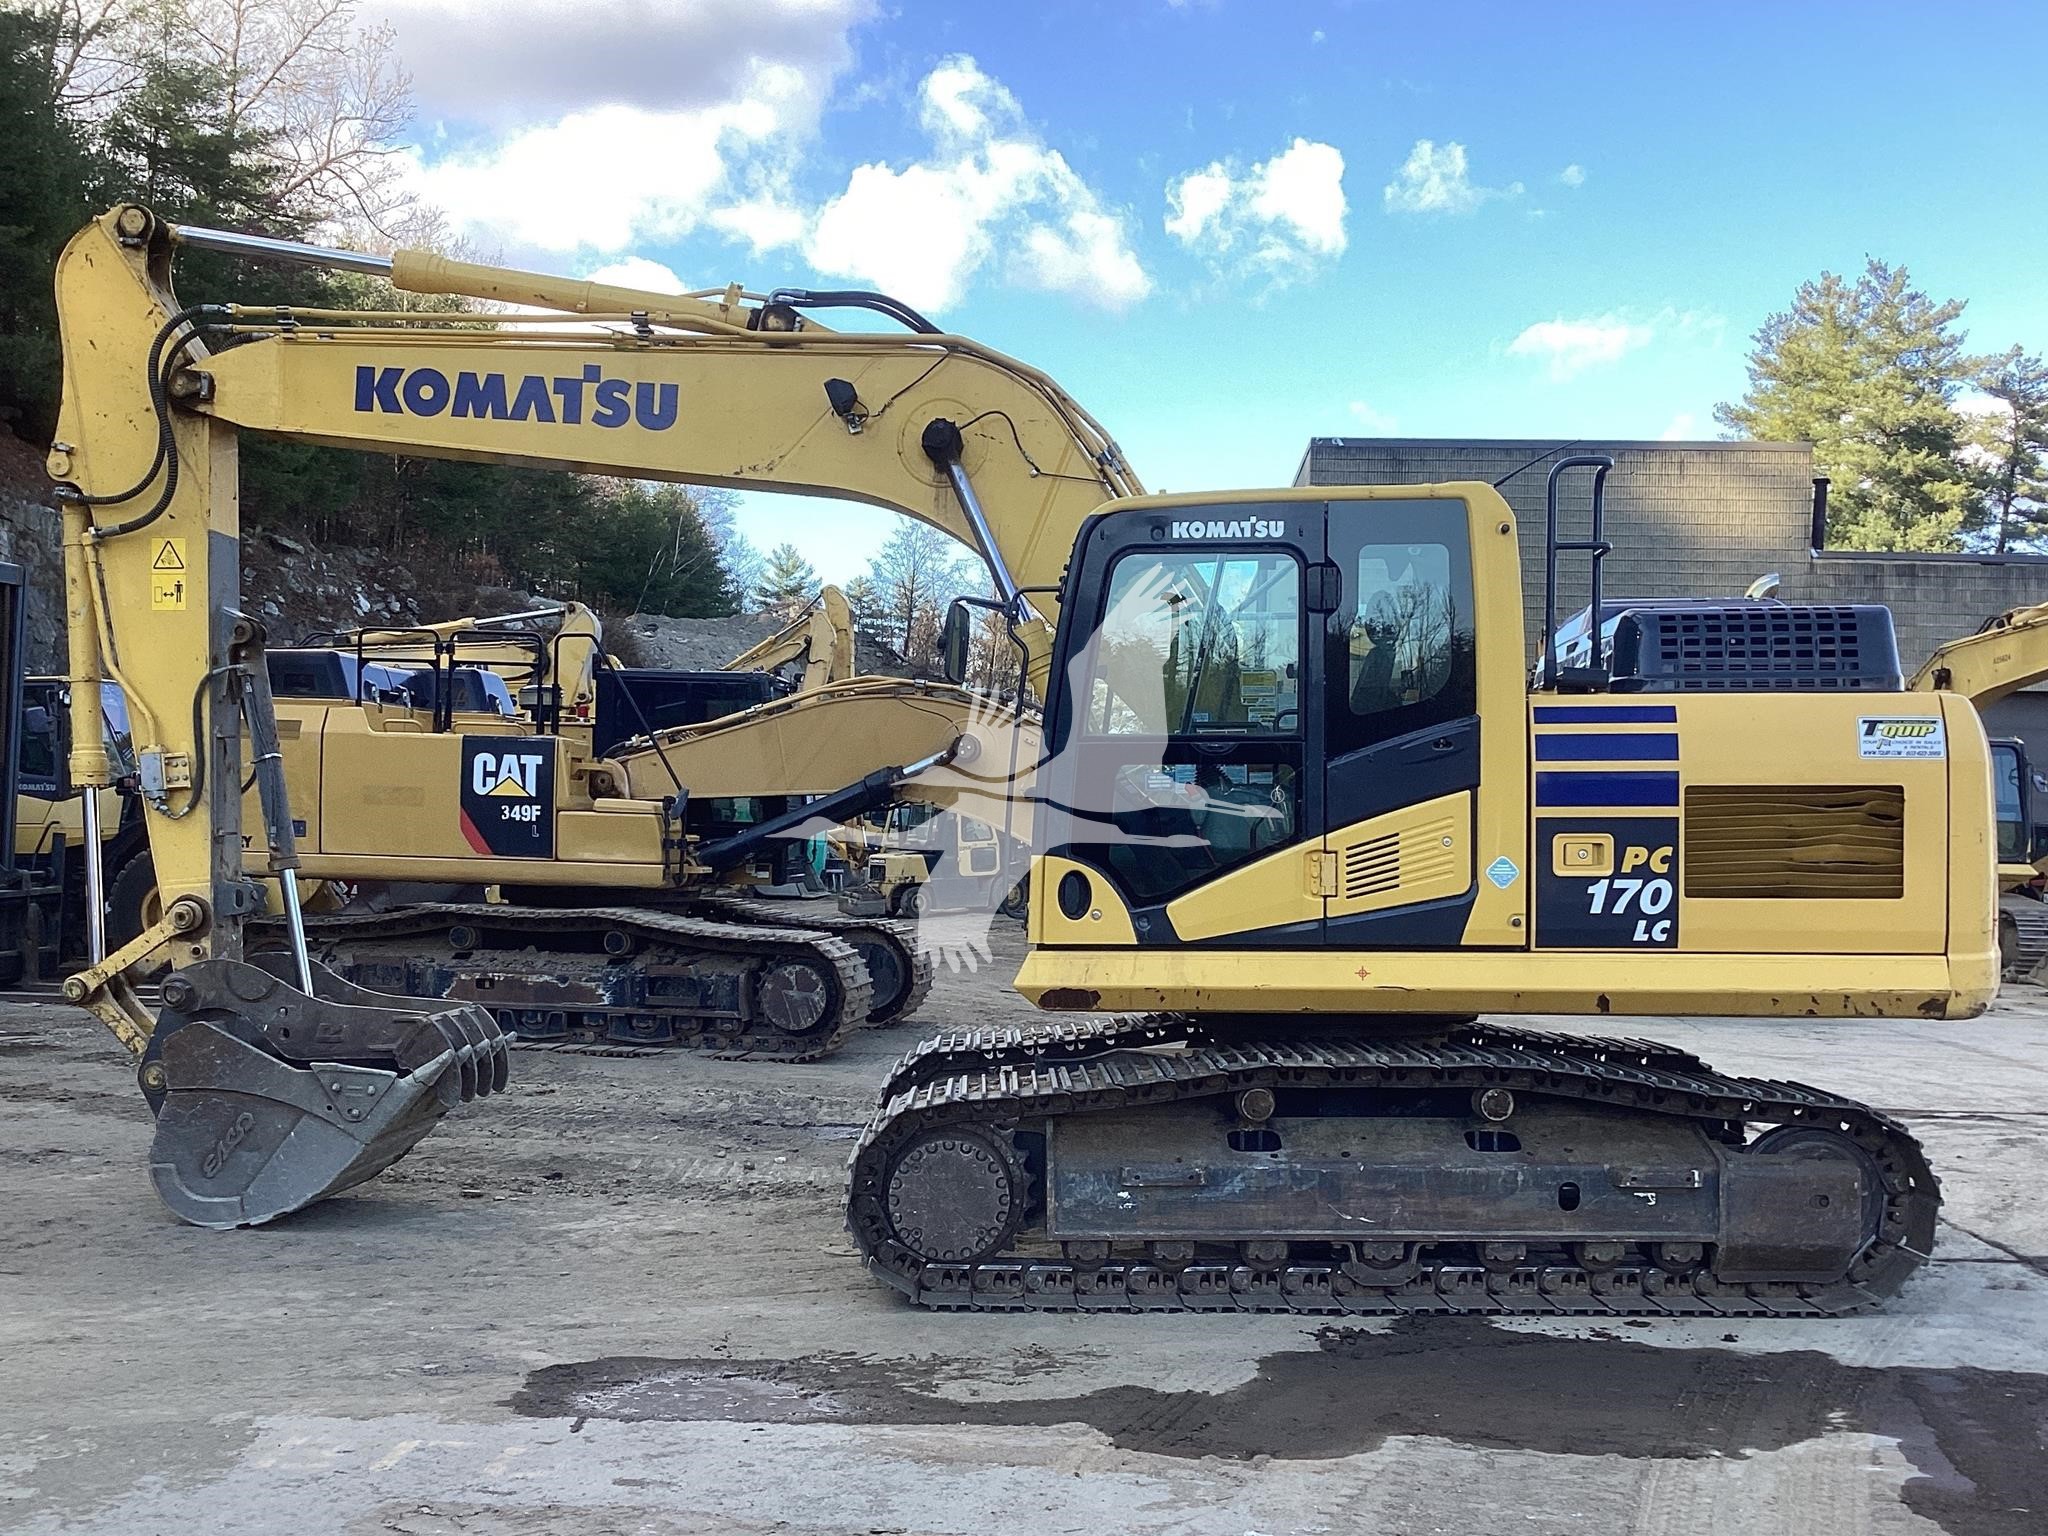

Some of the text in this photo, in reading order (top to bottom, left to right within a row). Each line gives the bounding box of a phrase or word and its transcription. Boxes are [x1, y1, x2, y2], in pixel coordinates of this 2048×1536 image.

[354, 364, 679, 431] KOMATSU
[1172, 516, 1285, 539] KOMATSU
[473, 752, 543, 797] CAT
[501, 804, 542, 822] 349F
[1620, 846, 1674, 874] PC
[1587, 878, 1673, 915] 170
[1632, 920, 1672, 941] LC
